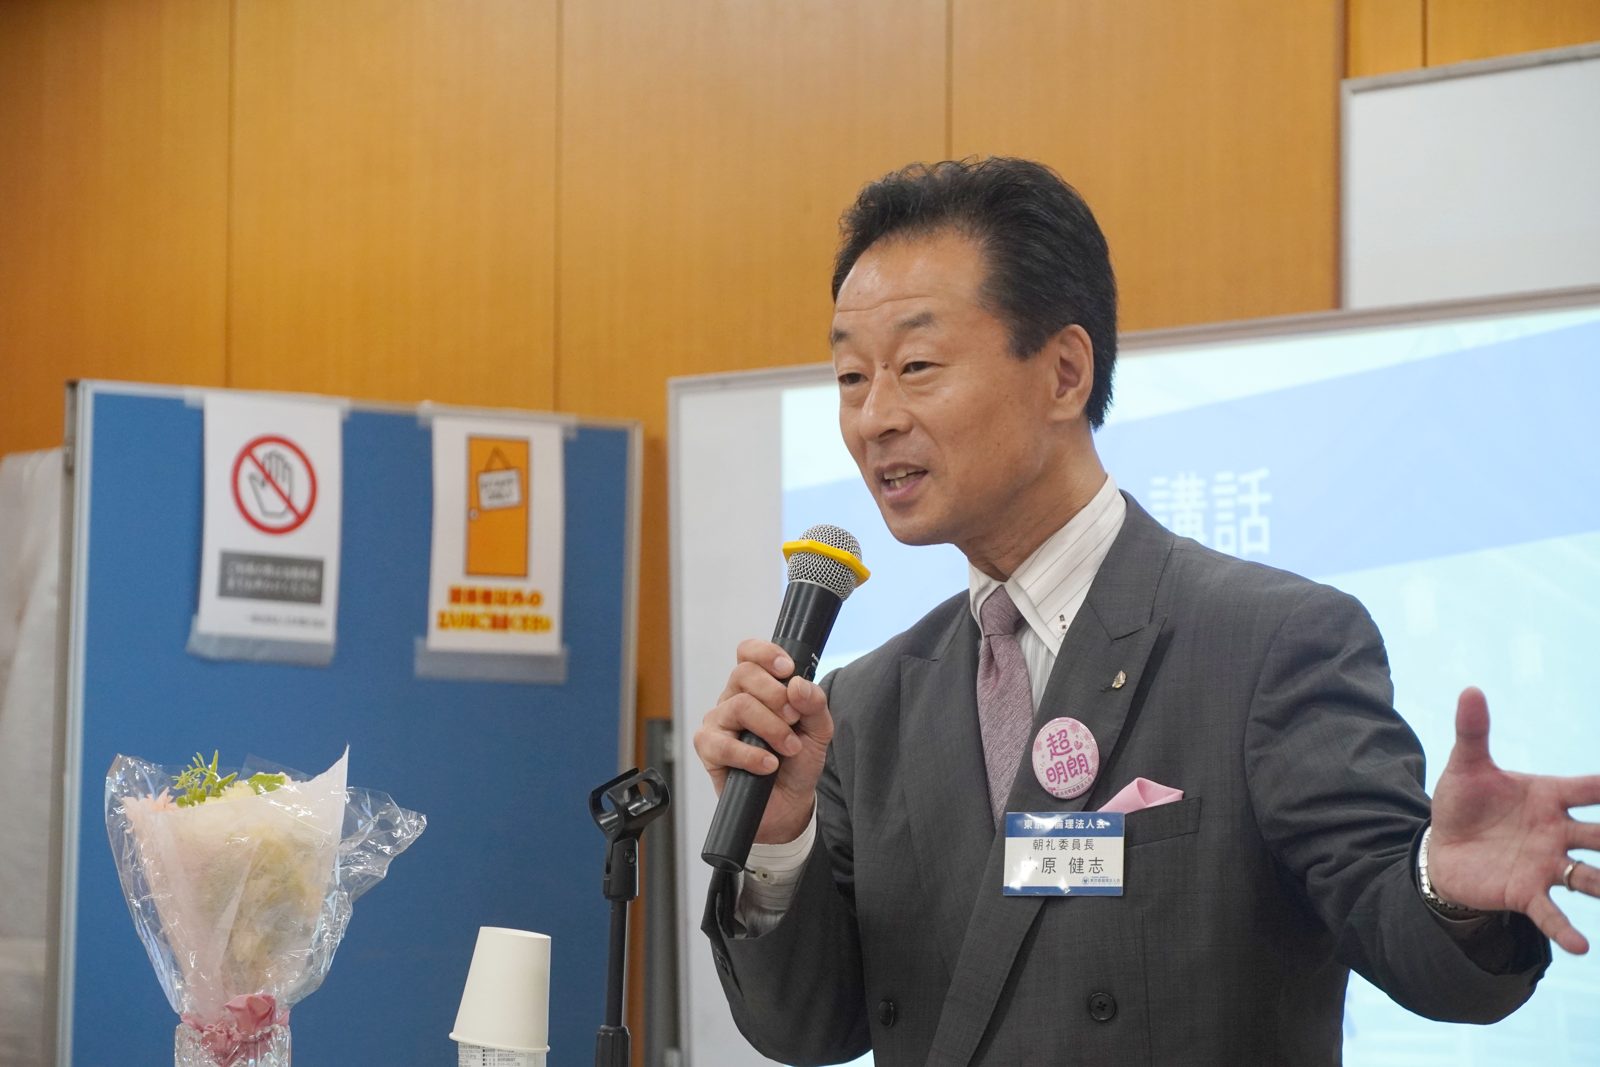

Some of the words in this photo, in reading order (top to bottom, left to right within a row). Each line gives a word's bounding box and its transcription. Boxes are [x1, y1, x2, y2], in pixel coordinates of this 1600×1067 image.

[1149, 467, 1272, 554] 講話
[1046, 728, 1073, 761] 超
[1046, 752, 1089, 784] 明朗
[1023, 818, 1106, 830] 東倫理法人会
[1033, 838, 1095, 851] 朝礼委員長
[1068, 857, 1104, 874] 健志
